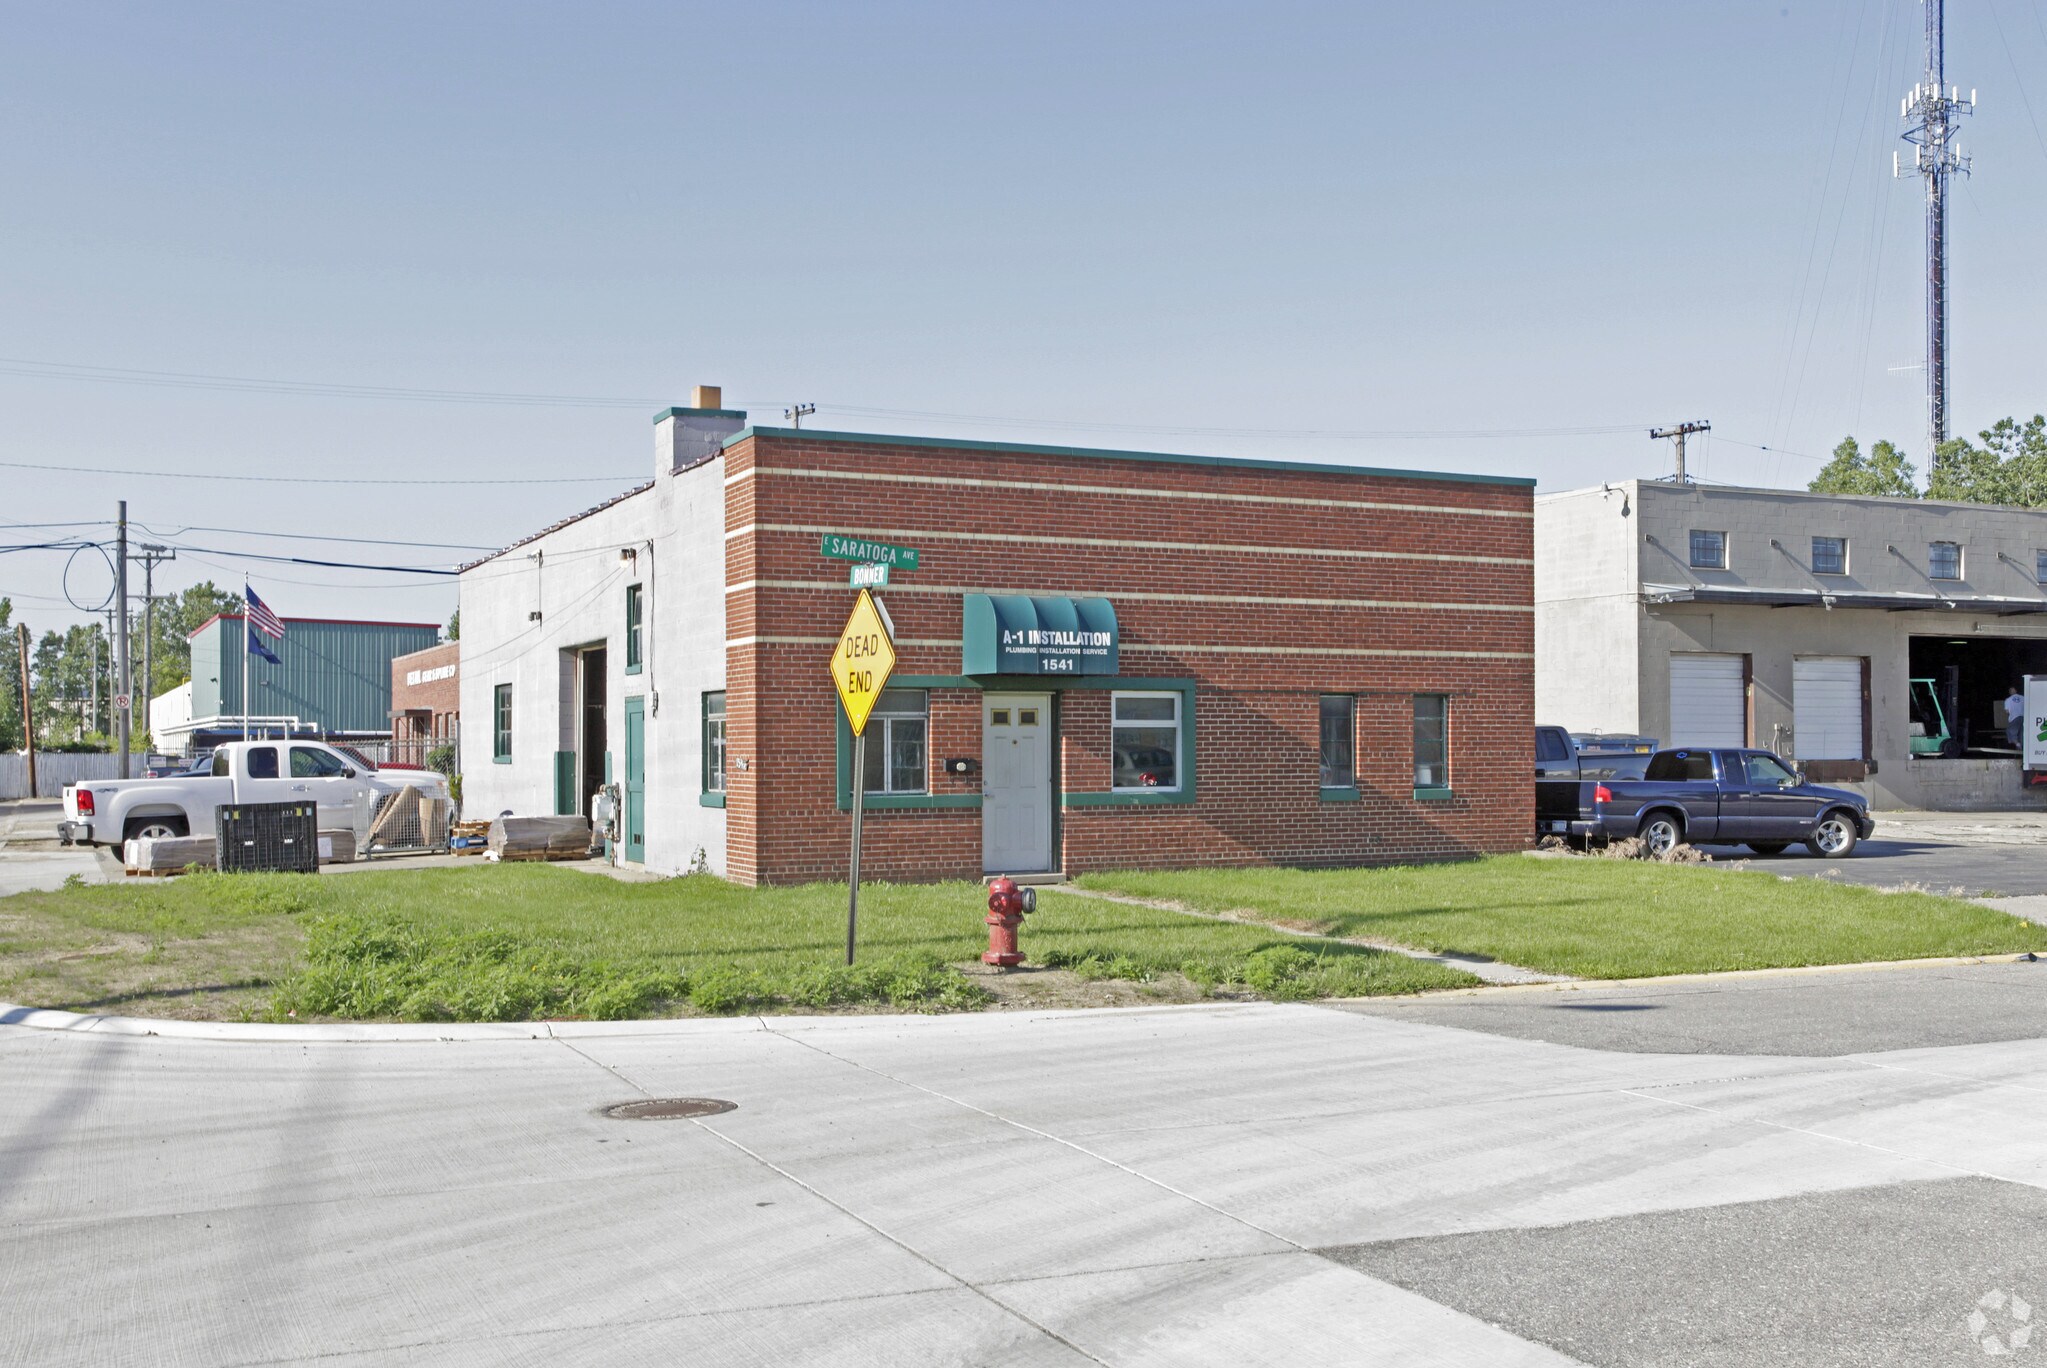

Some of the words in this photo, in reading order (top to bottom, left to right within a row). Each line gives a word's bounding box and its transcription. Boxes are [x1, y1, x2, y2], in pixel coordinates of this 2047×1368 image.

[824, 536, 829, 545] E
[832, 538, 896, 564] SARATOGA
[902, 550, 915, 560] AVE
[846, 634, 879, 658] DEAD
[1003, 630, 1024, 644] A-1
[1028, 630, 1111, 647] INSTALLATION
[1006, 646, 1037, 654] PLUMBING
[1039, 647, 1081, 655] INSTALLATION
[1042, 659, 1073, 671] 1541
[849, 671, 872, 693] END
